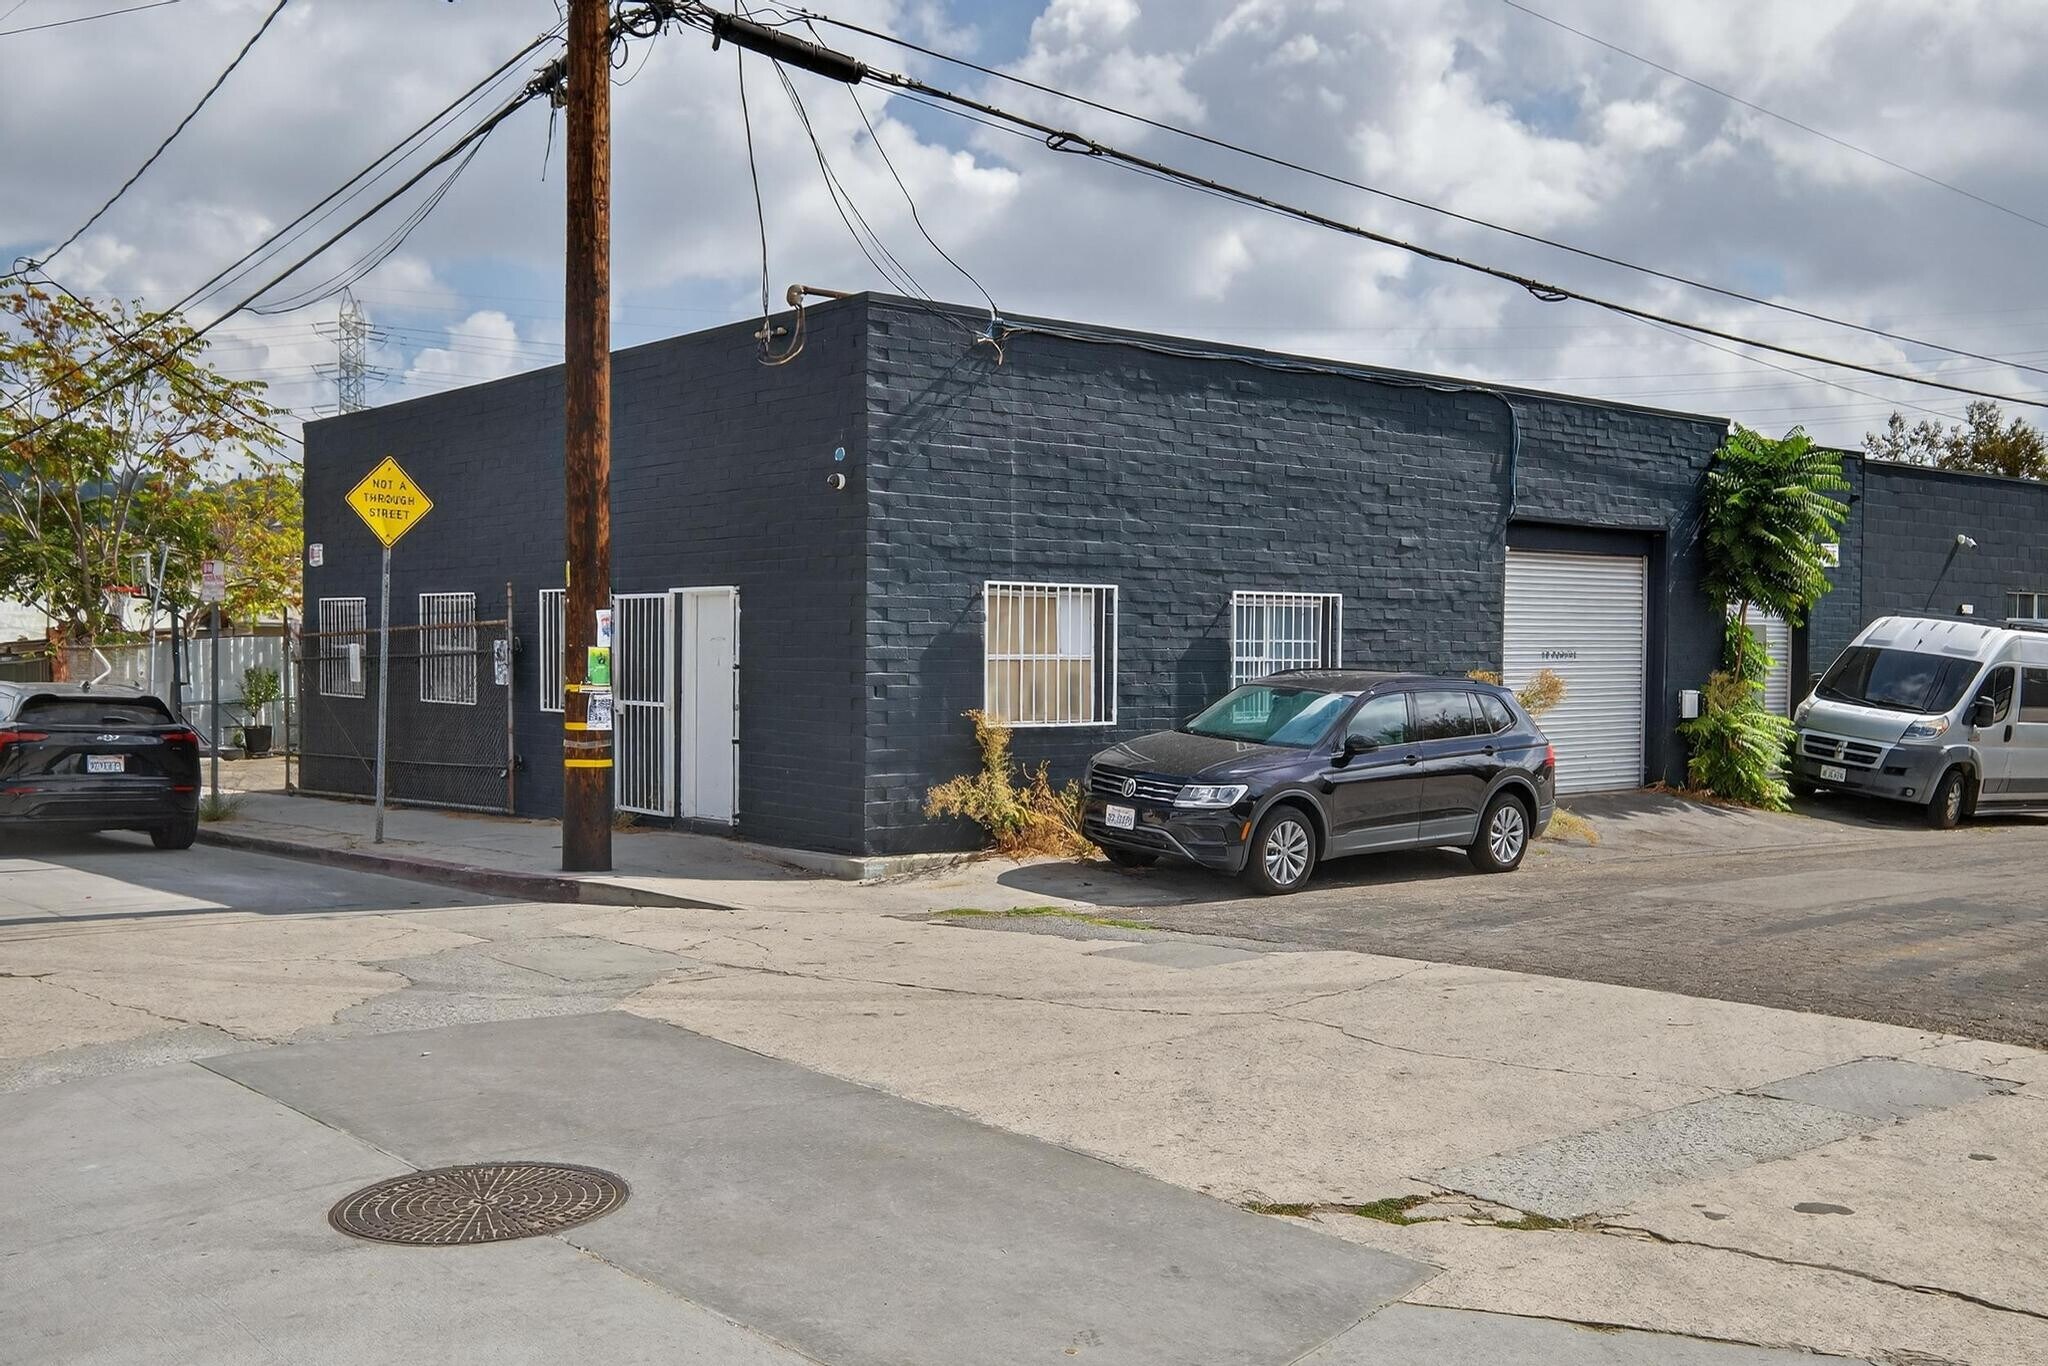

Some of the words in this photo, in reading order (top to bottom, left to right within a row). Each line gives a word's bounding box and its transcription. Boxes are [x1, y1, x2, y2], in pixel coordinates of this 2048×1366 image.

[373, 480, 392, 490] NOT
[400, 482, 407, 490] A
[364, 493, 414, 505] THROUGH
[369, 508, 409, 519] STREET
